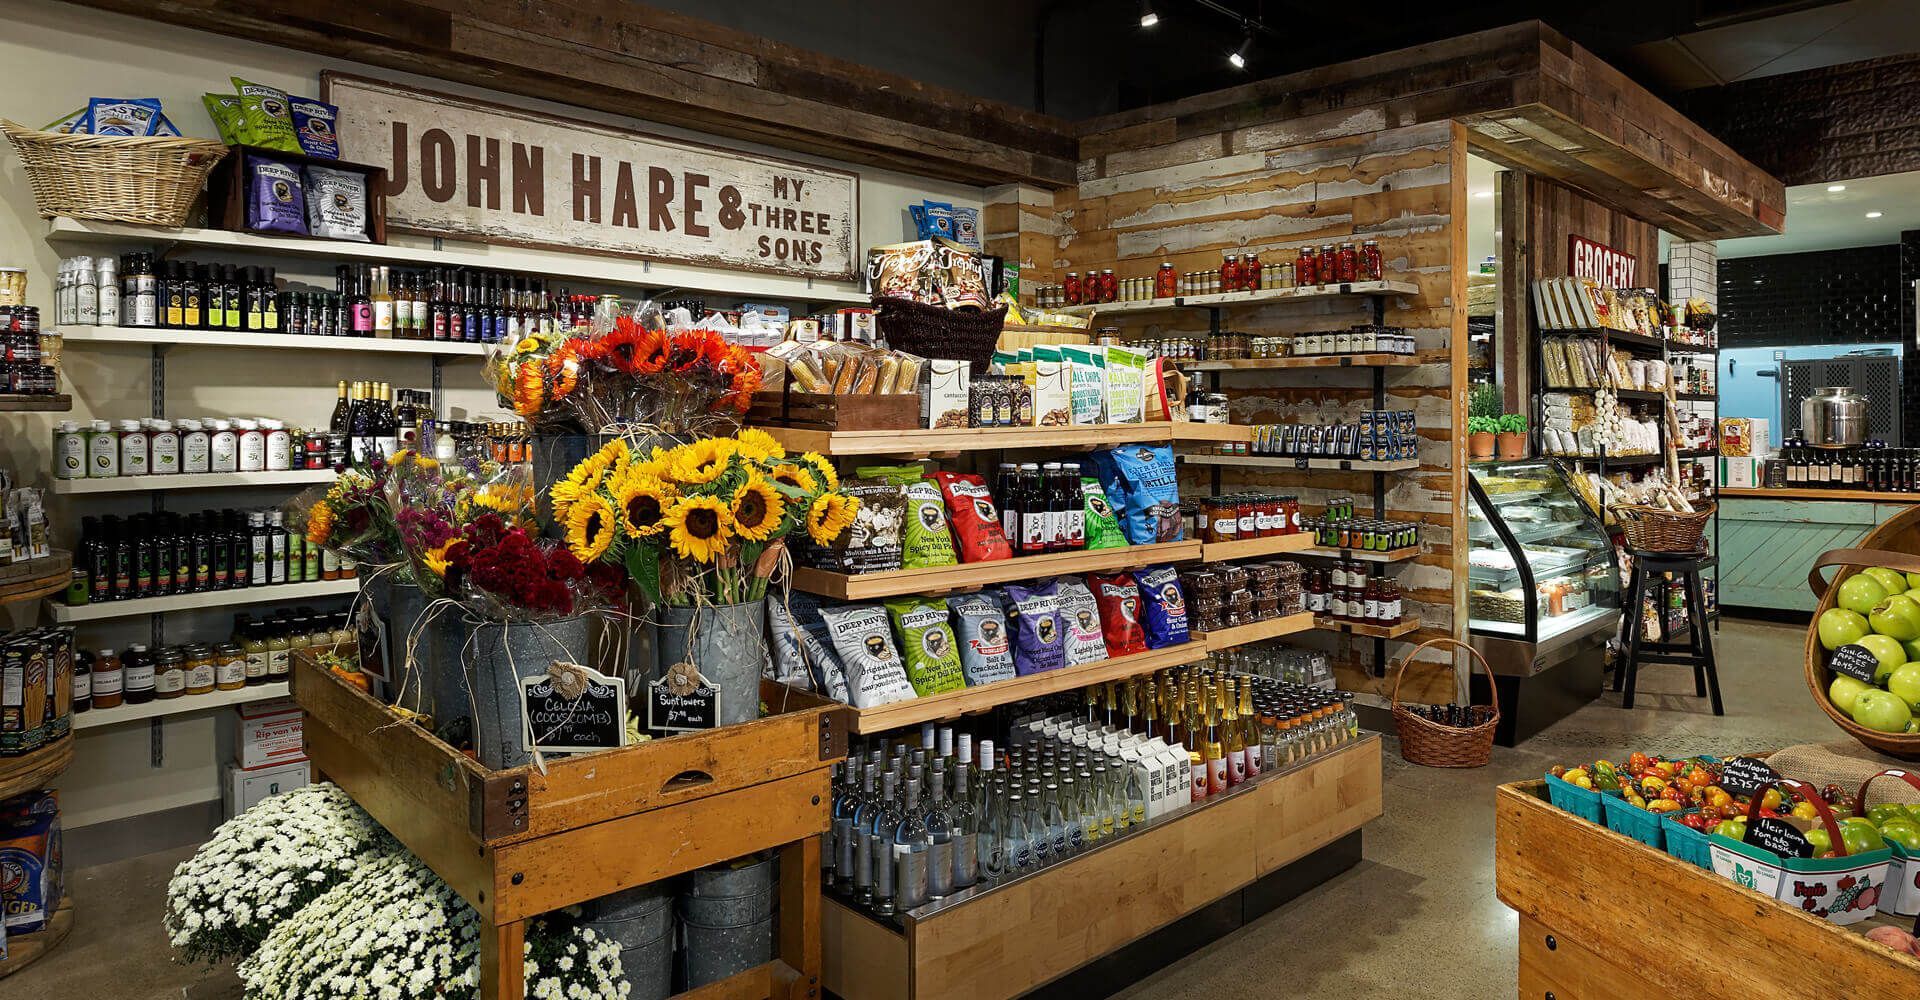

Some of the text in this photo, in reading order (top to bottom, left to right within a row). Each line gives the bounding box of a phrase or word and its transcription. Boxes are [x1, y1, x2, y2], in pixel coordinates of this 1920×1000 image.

[386, 121, 747, 237] JOHN HARE &
[774, 175, 805, 202] MY
[748, 203, 831, 236] THREE
[758, 235, 824, 265] SONS
[939, 247, 982, 282] Trophy
[1574, 239, 1636, 291] GROCERY
[910, 544, 930, 555] Spicy
[902, 609, 949, 625] DEEP RIVER
[958, 605, 979, 613] DEEP
[838, 614, 887, 634] DEEP RIVER
[1074, 645, 1092, 655] Lightly
[926, 660, 957, 674] New York
[986, 655, 999, 663] Salt
[1837, 652, 1867, 668] APPLES
[861, 663, 889, 676] Original
[970, 663, 998, 674] Cracked
[915, 674, 937, 686] Spicy
[937, 669, 950, 679] Dill
[545, 698, 595, 712] CELOSIA
[660, 694, 706, 708] Sunflowers
[687, 714, 703, 723] each
[256, 730, 271, 739] Rip
[273, 728, 289, 736] van
[573, 732, 601, 742] each
[1731, 759, 1770, 775] Heirloom
[1753, 827, 1789, 847] tomato
[1761, 819, 1805, 845] Heirloom
[1764, 839, 1800, 858] basket
